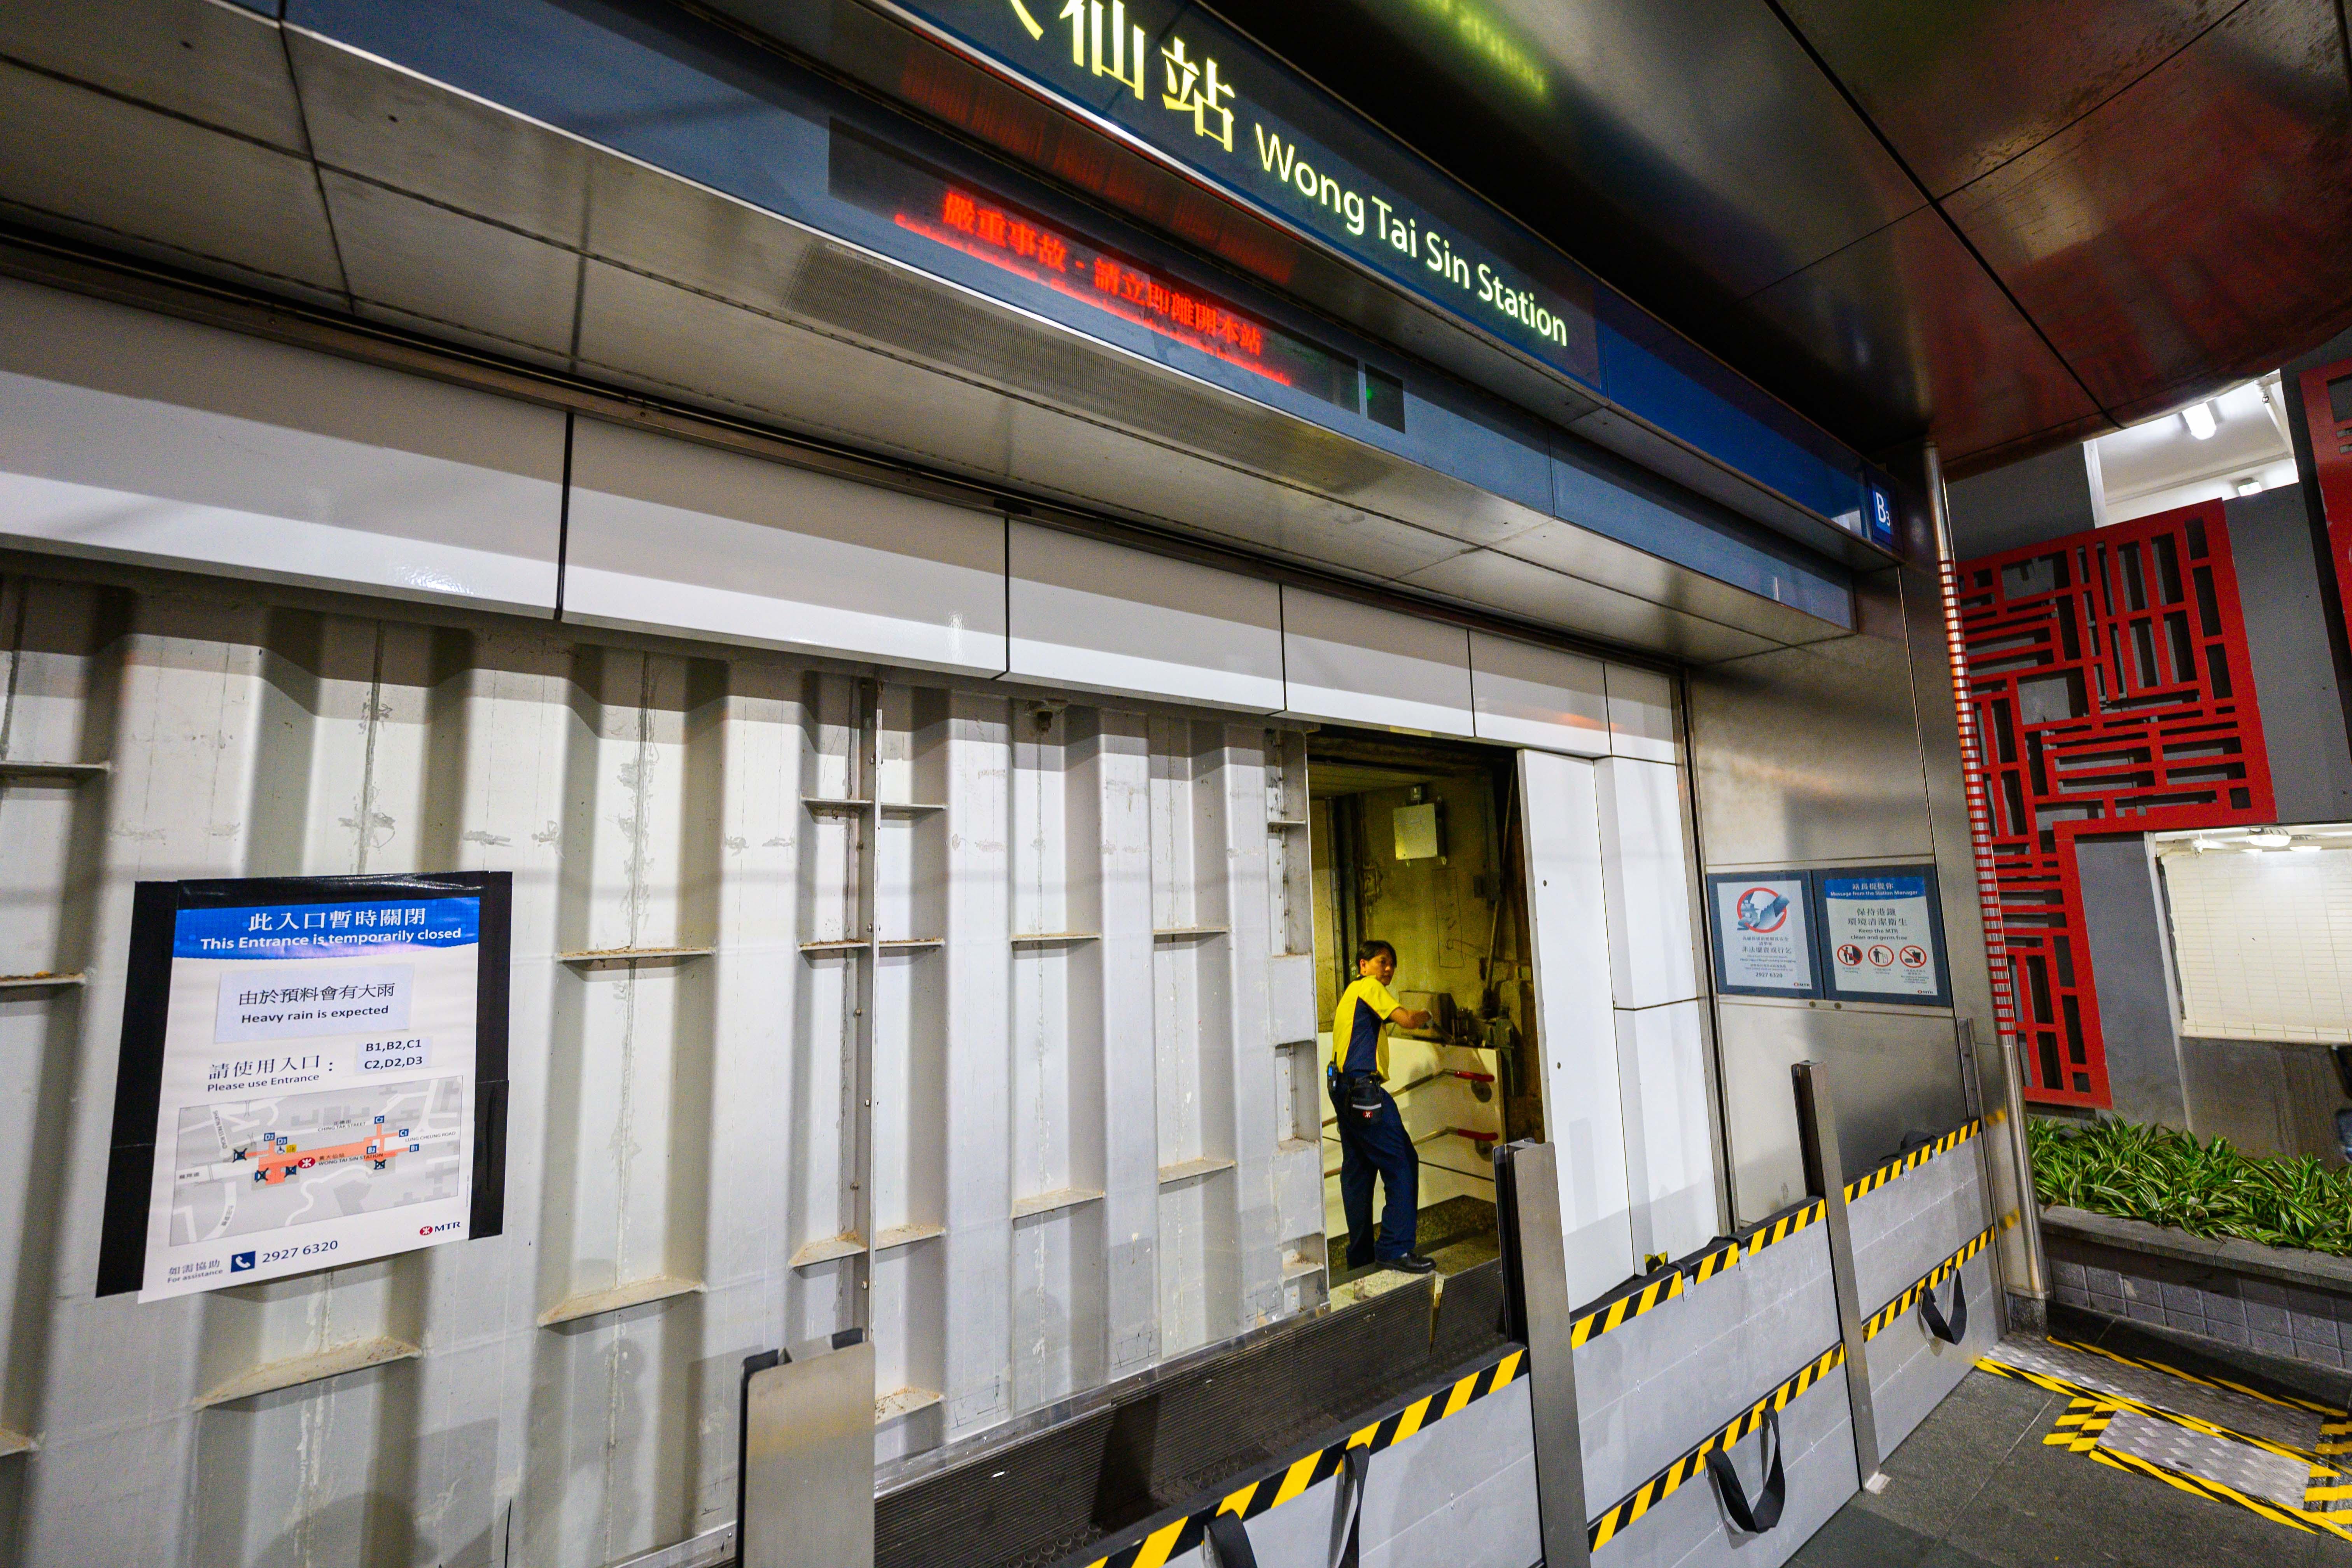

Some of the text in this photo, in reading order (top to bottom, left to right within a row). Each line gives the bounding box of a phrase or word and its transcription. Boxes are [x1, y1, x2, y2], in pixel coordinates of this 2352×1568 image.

[1011, 0, 1236, 152] 仙站
[1255, 122, 1568, 346] Wong Tai Sin Station
[1876, 492, 1891, 527] B3
[248, 908, 426, 932] 此入口暫時關閉
[200, 928, 461, 950] This Entrance is temporarily closed
[239, 983, 395, 1005] 由於預料會有大雨
[242, 1005, 388, 1023] Heavy rain is expected
[366, 1039, 421, 1052] B1,B2,C1
[364, 1056, 423, 1070] C2,D2,D3
[208, 1074, 319, 1092] Please use Entrance
[435, 1222, 460, 1232] MTR
[262, 1240, 338, 1263] 2927 6320
[169, 1259, 220, 1276] 如需協助
[182, 1269, 223, 1280] assistance
